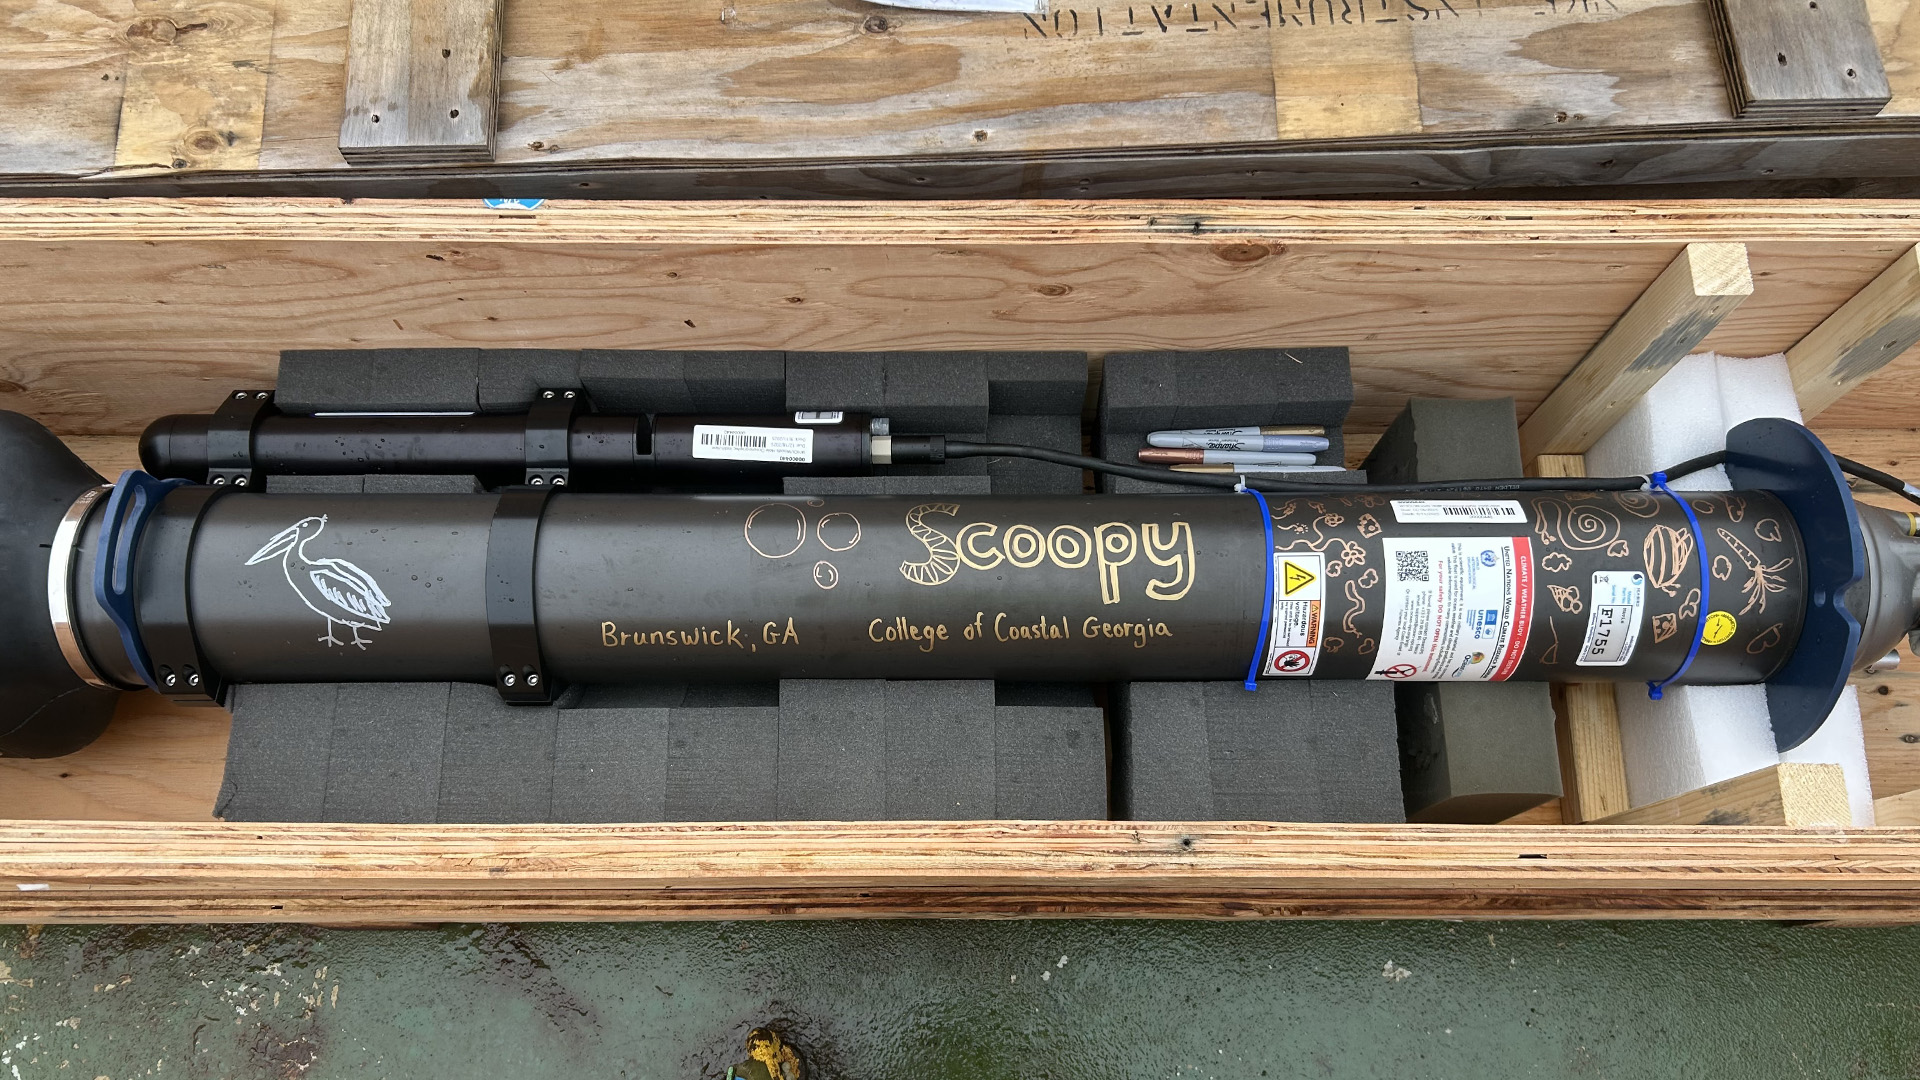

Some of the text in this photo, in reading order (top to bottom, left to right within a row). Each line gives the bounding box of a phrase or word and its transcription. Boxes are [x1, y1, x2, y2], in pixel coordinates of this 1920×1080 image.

[899, 503, 1195, 604] Scoopy
[1300, 602, 1308, 636] Hazardous
[1438, 605, 1443, 614] DO
[1474, 610, 1484, 639] unesco
[601, 619, 799, 651] Brunswick, GA
[868, 612, 1173, 651] College of Coastal Georgia
[1309, 613, 1317, 644] WARNING
[1517, 621, 1525, 636] BUOY
[1592, 608, 1613, 655] F1755
